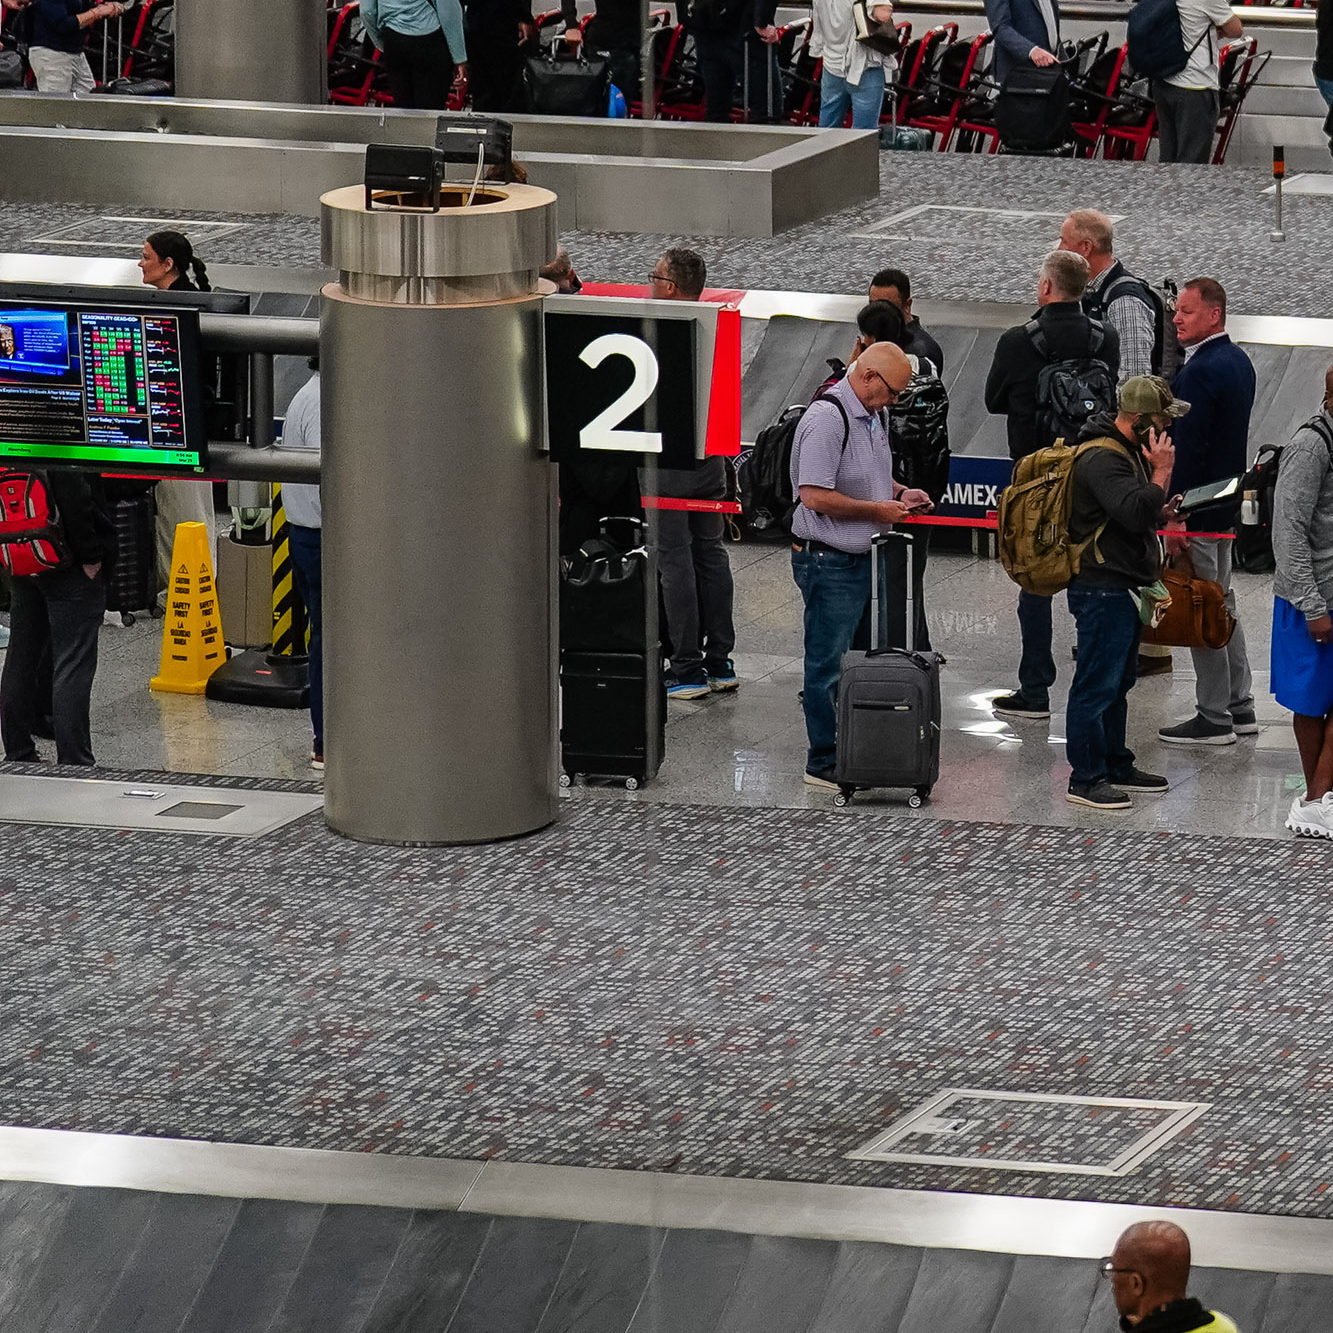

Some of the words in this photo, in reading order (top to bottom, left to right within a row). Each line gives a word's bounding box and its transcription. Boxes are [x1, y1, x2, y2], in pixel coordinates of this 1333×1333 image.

[578, 333, 662, 453] 2
[940, 482, 998, 506] AMEX
[172, 602, 191, 610] SAFETY
[174, 610, 188, 618] FIRST
